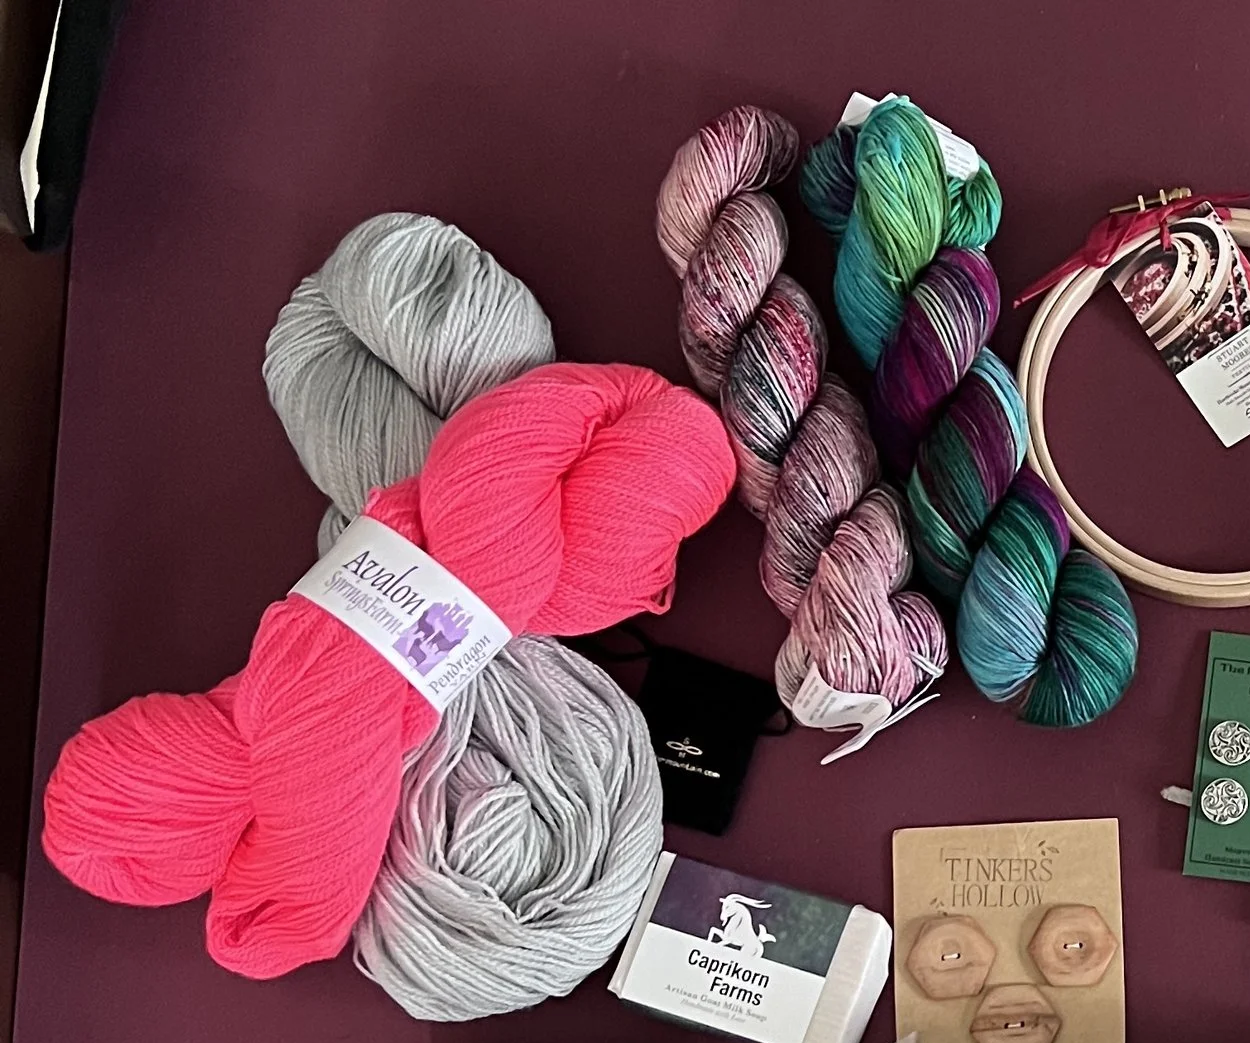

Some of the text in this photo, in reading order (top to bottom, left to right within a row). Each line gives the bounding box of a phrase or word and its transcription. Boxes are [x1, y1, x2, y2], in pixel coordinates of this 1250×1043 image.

[342, 551, 426, 615] Avalon
[428, 635, 491, 694] Pendragon
[1220, 662, 1245, 674] The
[945, 859, 1053, 882] TINKERS
[952, 883, 1044, 907] HOLLOW
[688, 949, 770, 988] Caprikorn
[710, 977, 763, 1006] Farms
